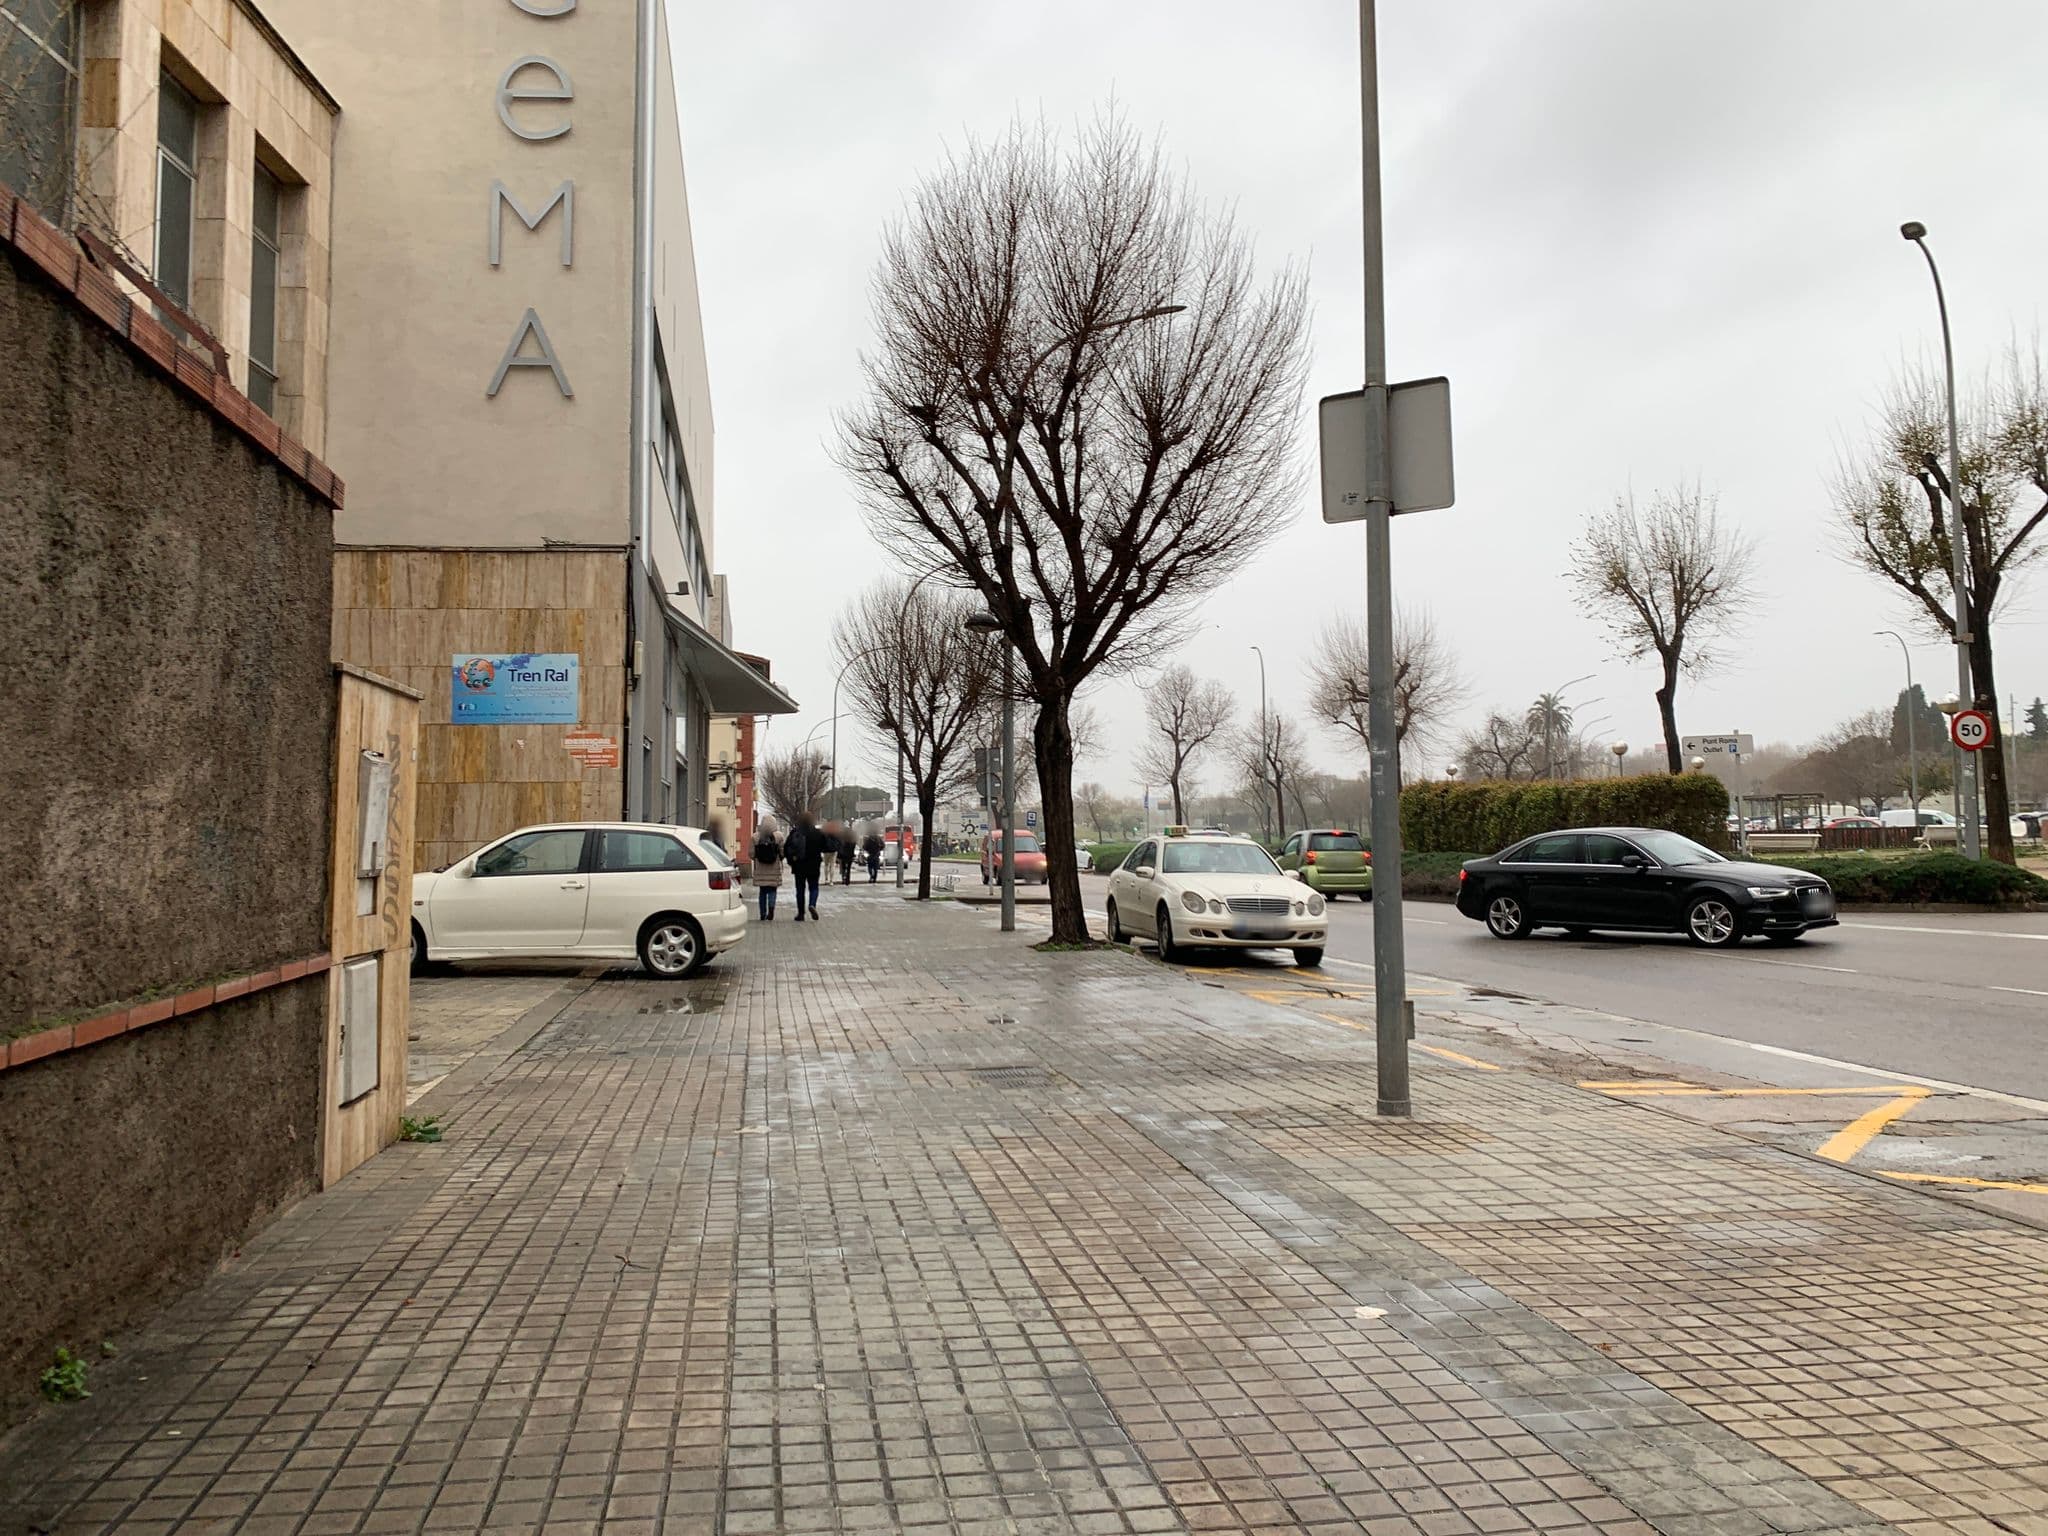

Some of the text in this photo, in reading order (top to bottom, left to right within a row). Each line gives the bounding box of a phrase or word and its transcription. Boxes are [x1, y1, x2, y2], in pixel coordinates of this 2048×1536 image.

[487, 0, 575, 399] eMA
[508, 669, 569, 682] Tren Ral
[1961, 723, 1982, 737] 50
